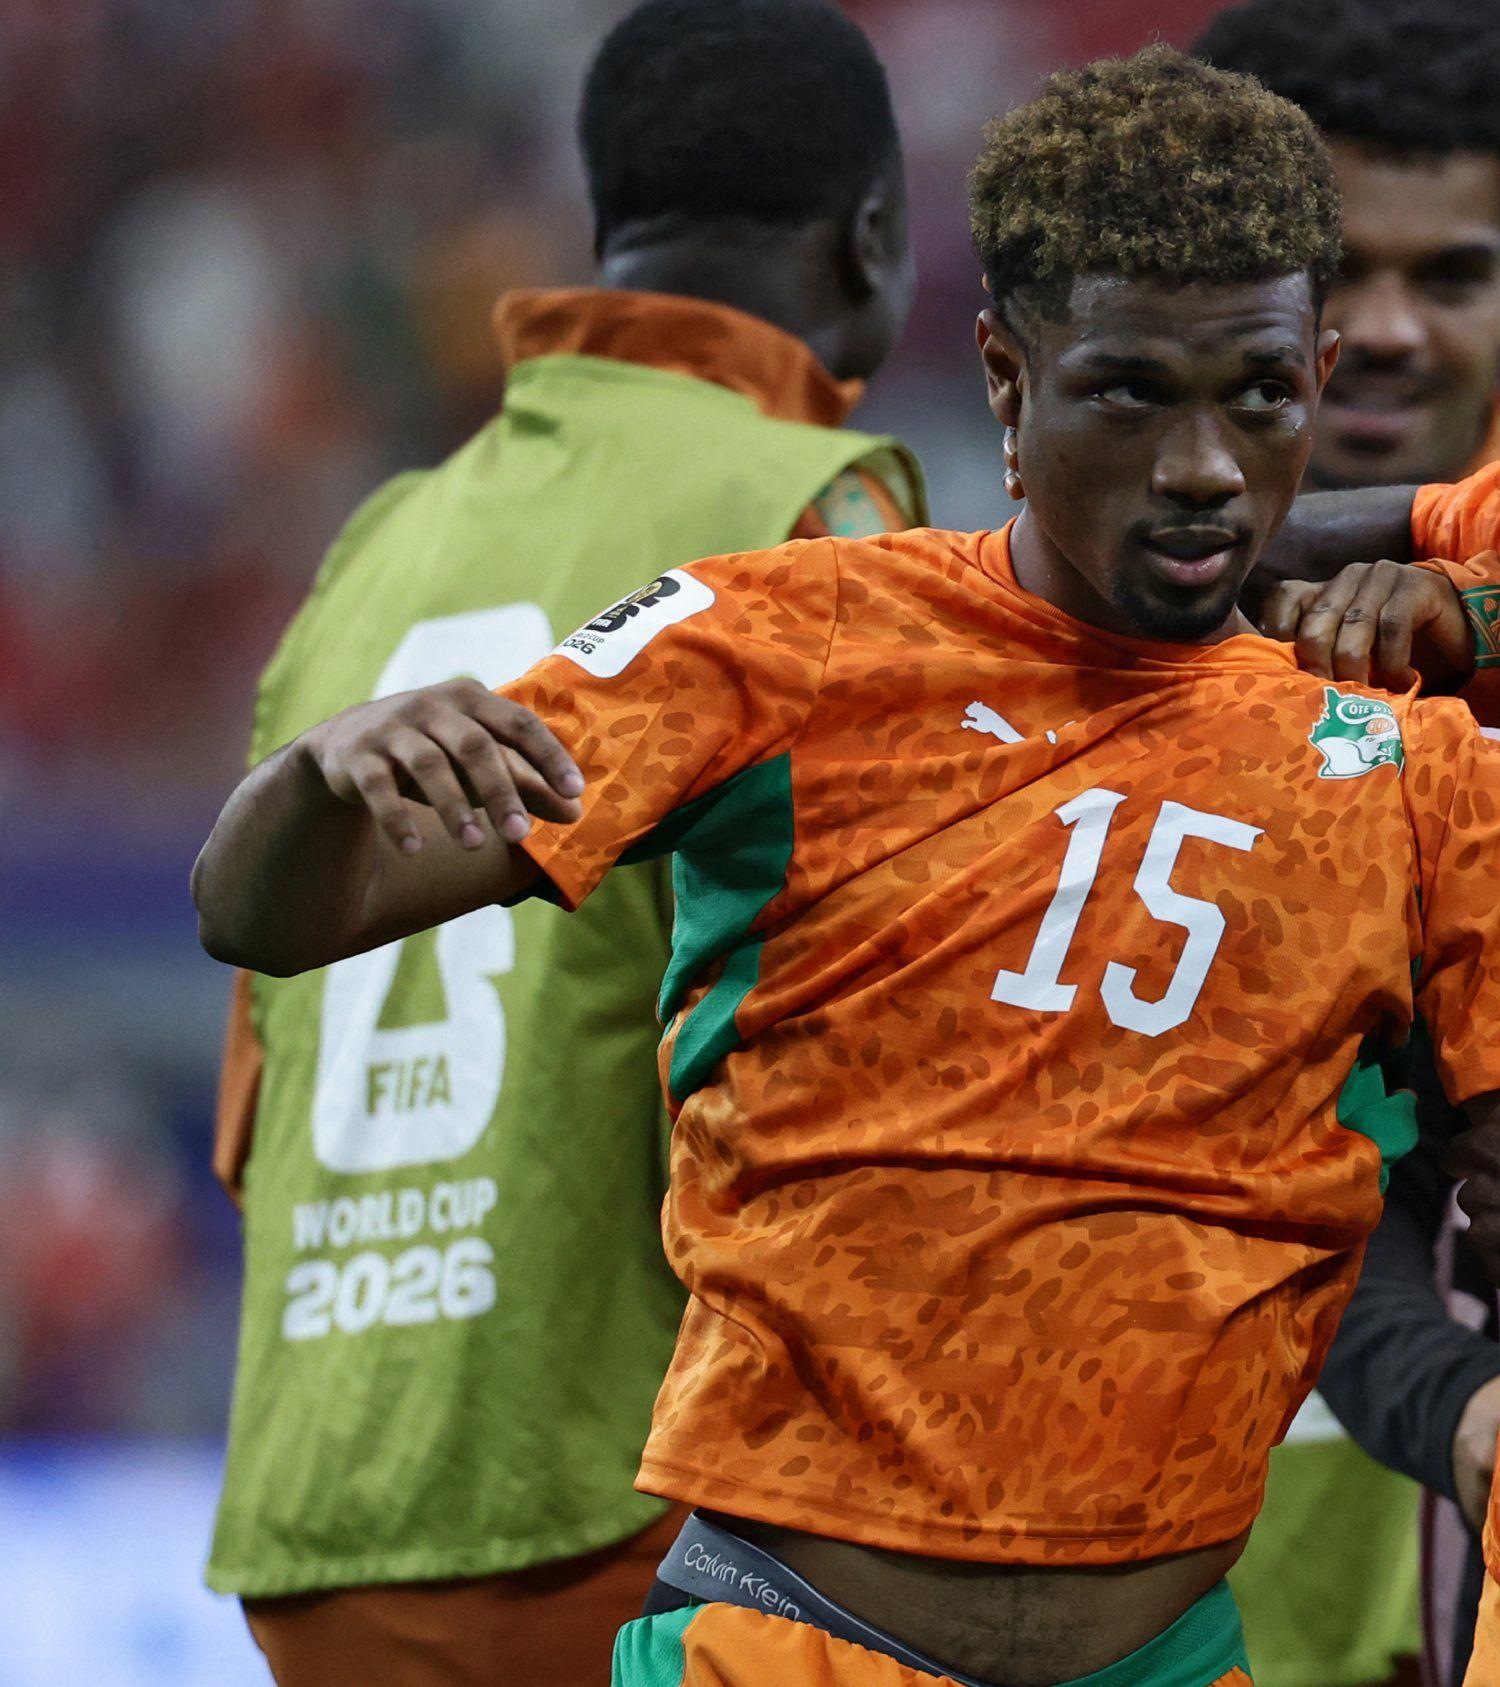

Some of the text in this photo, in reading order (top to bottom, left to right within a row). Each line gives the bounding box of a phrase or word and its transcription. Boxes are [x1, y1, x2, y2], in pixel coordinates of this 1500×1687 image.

[562, 638, 597, 655] 026
[990, 787, 1265, 1038] 15
[366, 1051, 453, 1117] FIFA
[293, 1176, 499, 1252] WORLD CUP
[282, 1236, 498, 1342] 2026
[684, 1542, 801, 1623] Calvin Klein
